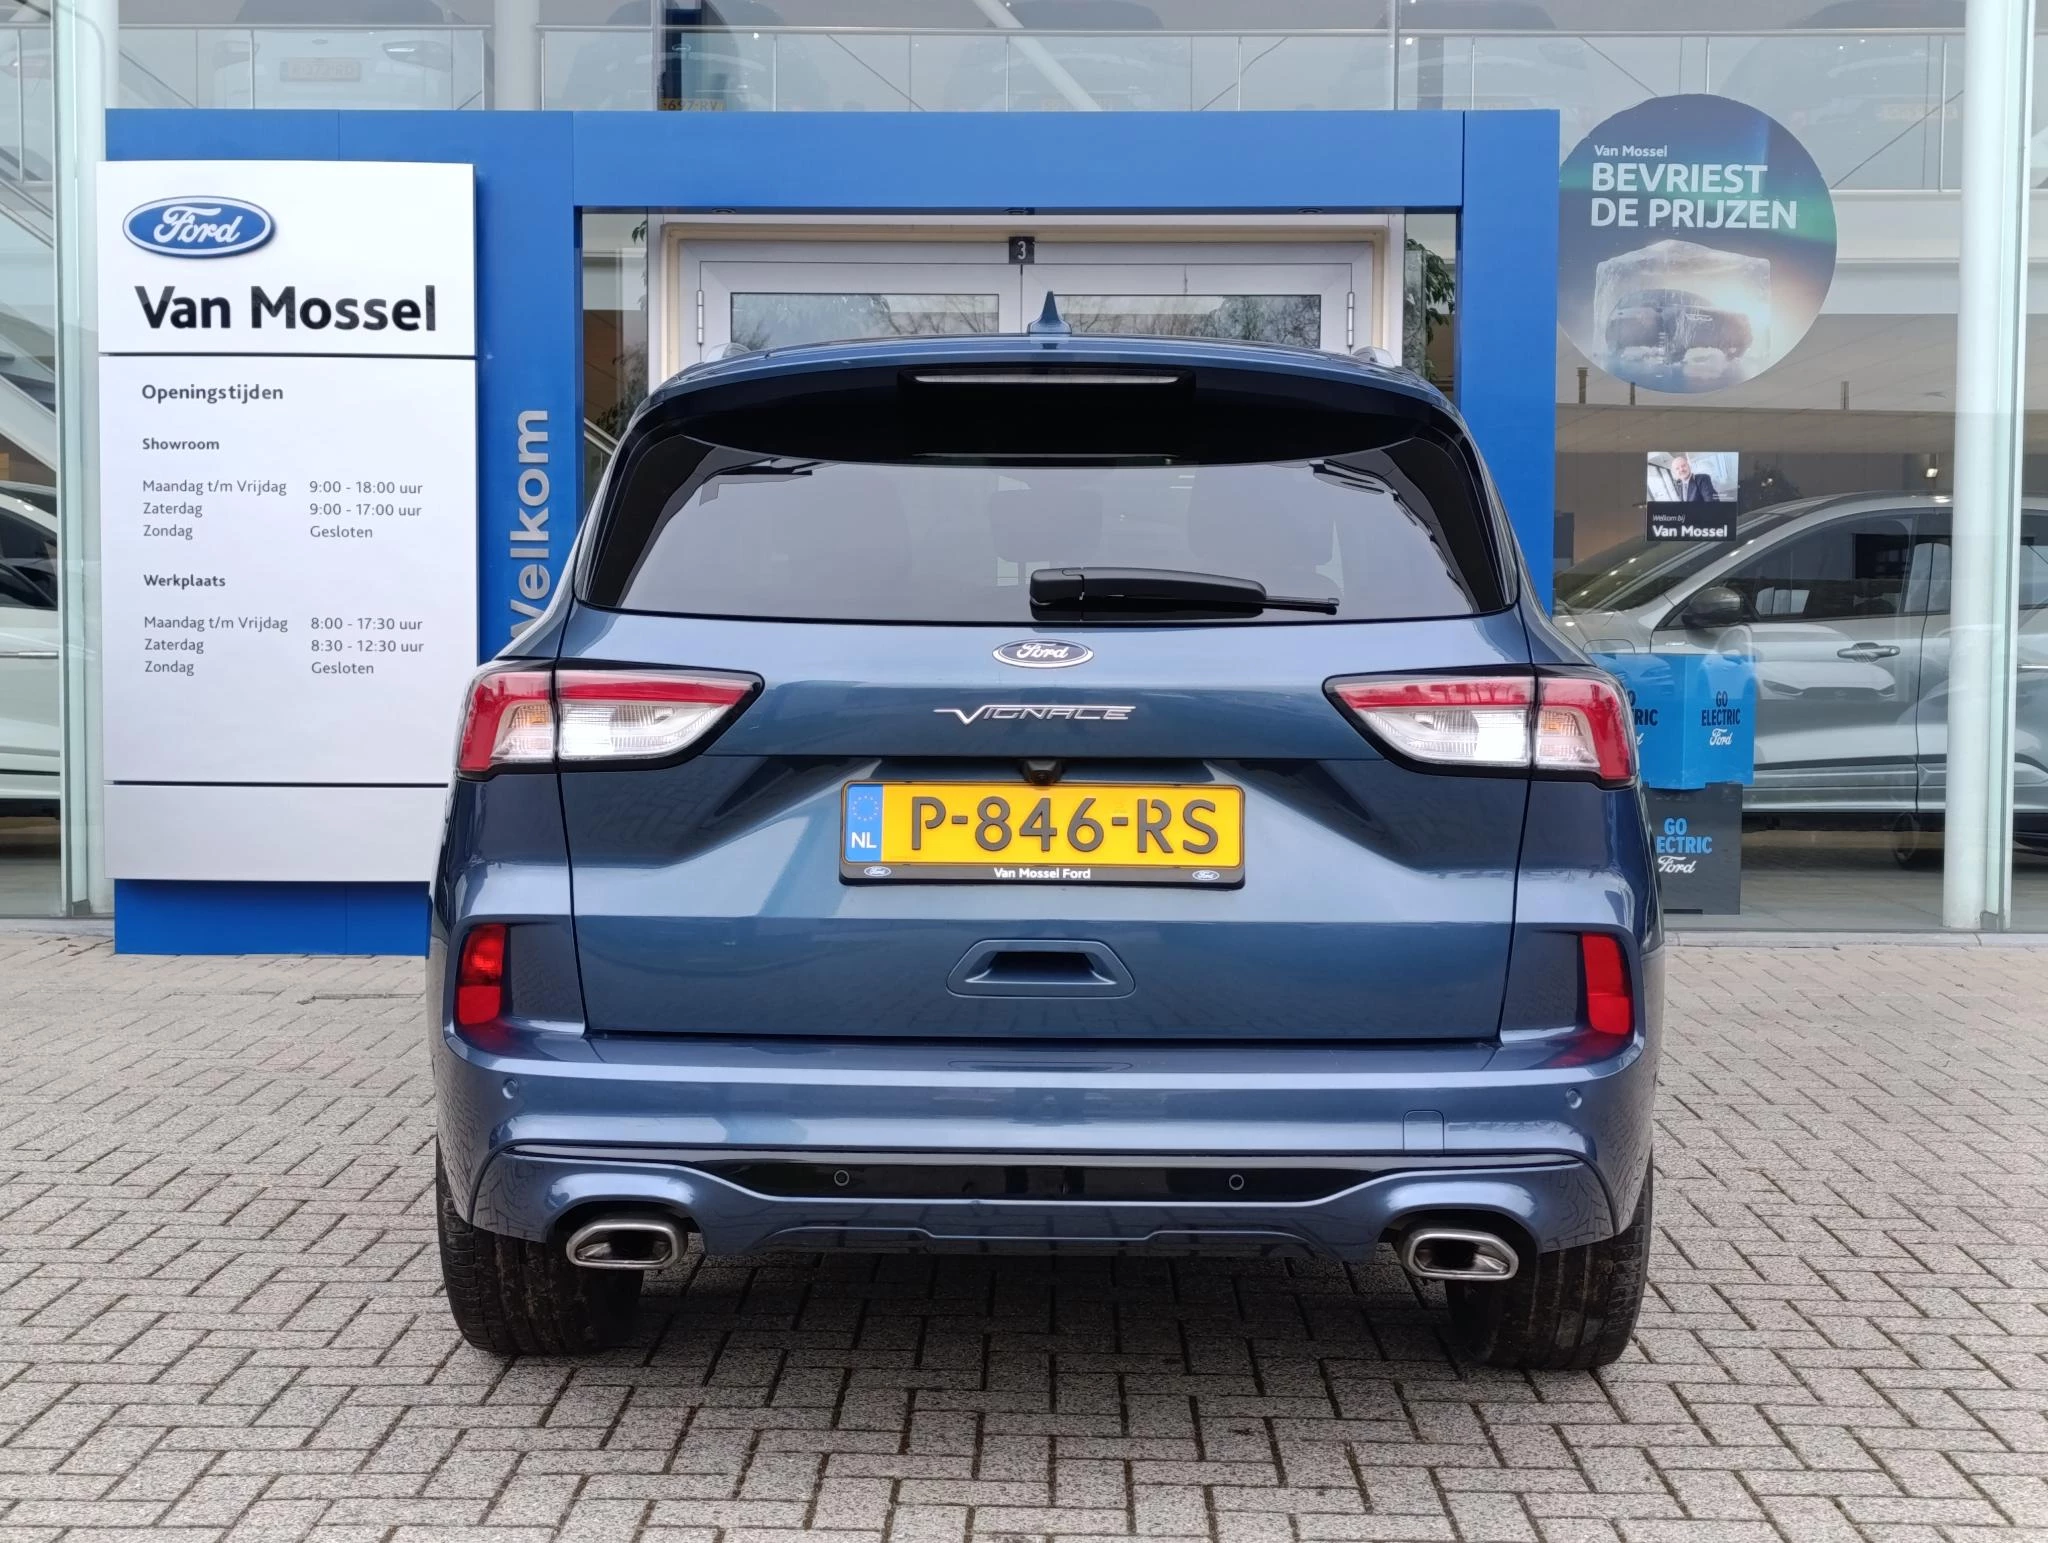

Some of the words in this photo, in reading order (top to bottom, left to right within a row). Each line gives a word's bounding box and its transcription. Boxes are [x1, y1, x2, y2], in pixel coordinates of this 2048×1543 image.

[1594, 145, 1618, 157] Van
[1622, 145, 1668, 157] Mossel
[1592, 162, 1768, 193] BEVRIEST
[1591, 197, 1639, 227] DE
[1649, 199, 1797, 229] PRIJZEN
[153, 206, 243, 243] Ford
[1017, 240, 1026, 260] 3
[134, 286, 231, 330] Van
[250, 285, 436, 331] Mossel
[142, 384, 284, 405] Openingstijden
[142, 437, 220, 451] Showroom
[143, 479, 204, 496] Maandag
[207, 479, 233, 493] t/m
[236, 479, 287, 497] Vrijdag
[309, 480, 342, 494] 9:00
[356, 481, 395, 495] 18:00
[399, 484, 423, 495] uur
[143, 501, 203, 519] Zaterdag
[309, 502, 342, 516] 9:00
[356, 503, 394, 516] 17:00
[399, 507, 422, 517] uur
[143, 524, 193, 541] Zondag
[309, 525, 373, 539] Gesloten
[1652, 524, 1678, 537] Van
[1681, 524, 1728, 537] Mossel
[143, 573, 226, 590] Werkplaats
[144, 615, 206, 632] Maandag
[208, 615, 234, 629] t/m
[238, 616, 289, 632] Vrijdag
[310, 617, 343, 630] 8:00
[357, 617, 395, 631] 17:30
[399, 620, 423, 631] uur
[144, 638, 204, 655] Zaterdag
[311, 639, 343, 653] 8:30
[357, 639, 396, 653] 12:30
[400, 643, 425, 653] uur
[1016, 643, 1069, 659] Ford
[144, 660, 195, 677] Zondag
[311, 661, 374, 675] Gesloten
[1716, 691, 1728, 707] GO
[1701, 708, 1741, 726] ELECTRIC
[1710, 728, 1733, 745] Ford
[911, 796, 1219, 854] P-846-RS
[1664, 817, 1687, 835] GO
[850, 831, 877, 849] NL
[1656, 836, 1712, 854] ECTRIC
[994, 867, 1016, 879] Van
[1019, 867, 1059, 879] Mossel
[1062, 868, 1091, 879] Ford
[1658, 855, 1697, 873] Ford
